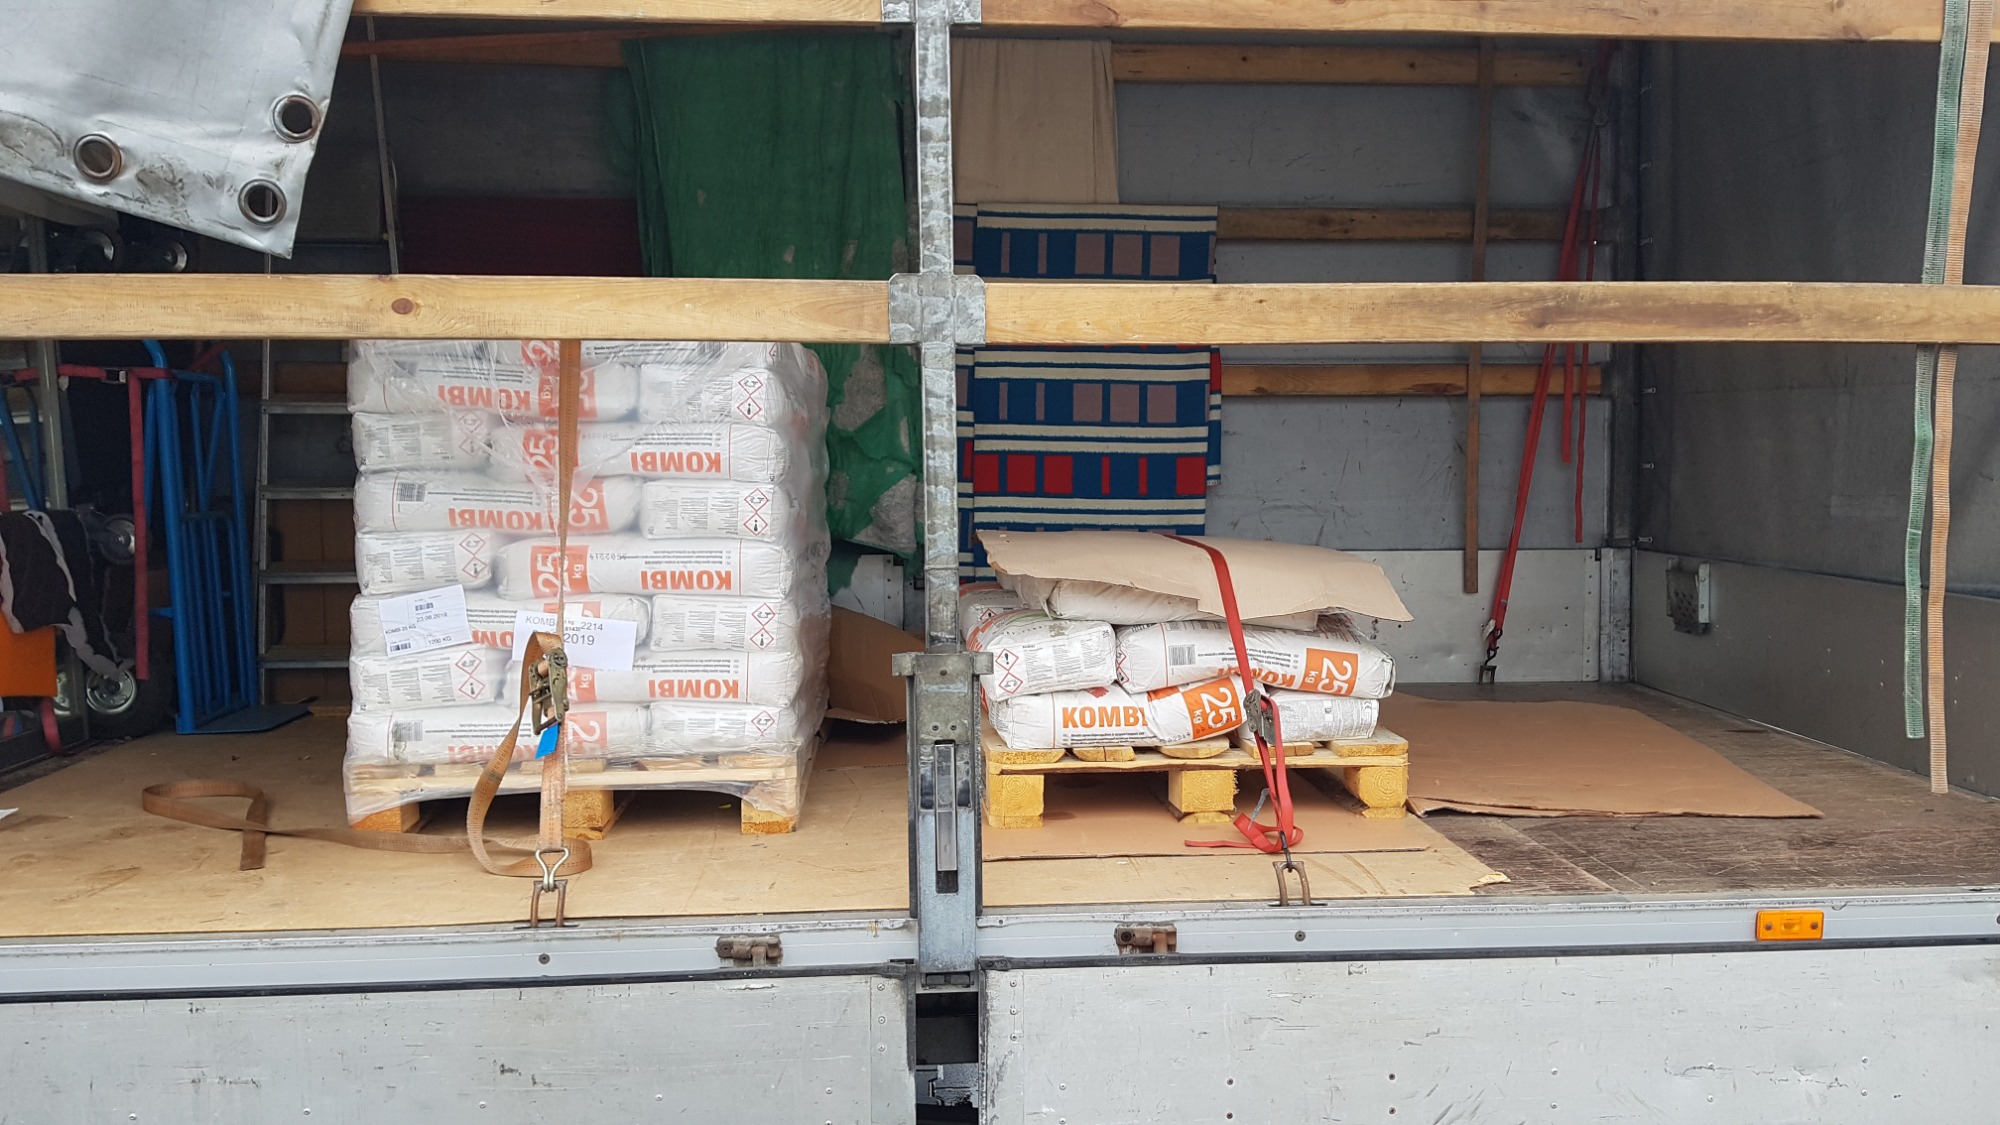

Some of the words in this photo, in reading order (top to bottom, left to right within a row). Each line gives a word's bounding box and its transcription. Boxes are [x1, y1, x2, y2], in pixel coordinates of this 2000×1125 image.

[438, 385, 531, 411] KOMBI
[630, 451, 721, 473] KOMBI
[567, 487, 600, 527] 25
[448, 507, 543, 530] KOMBI
[536, 552, 570, 593] 25
[572, 563, 584, 579] kg
[641, 570, 732, 590] KOMBI
[525, 615, 556, 627] KOMB
[580, 621, 603, 632] 2214
[580, 673, 592, 689] kg
[1304, 671, 1319, 684] kg
[1317, 657, 1352, 694] 25
[649, 679, 739, 699] KOMBI
[1062, 705, 1149, 729] KOMBI
[1193, 709, 1203, 724] kg
[1200, 687, 1237, 729] 25
